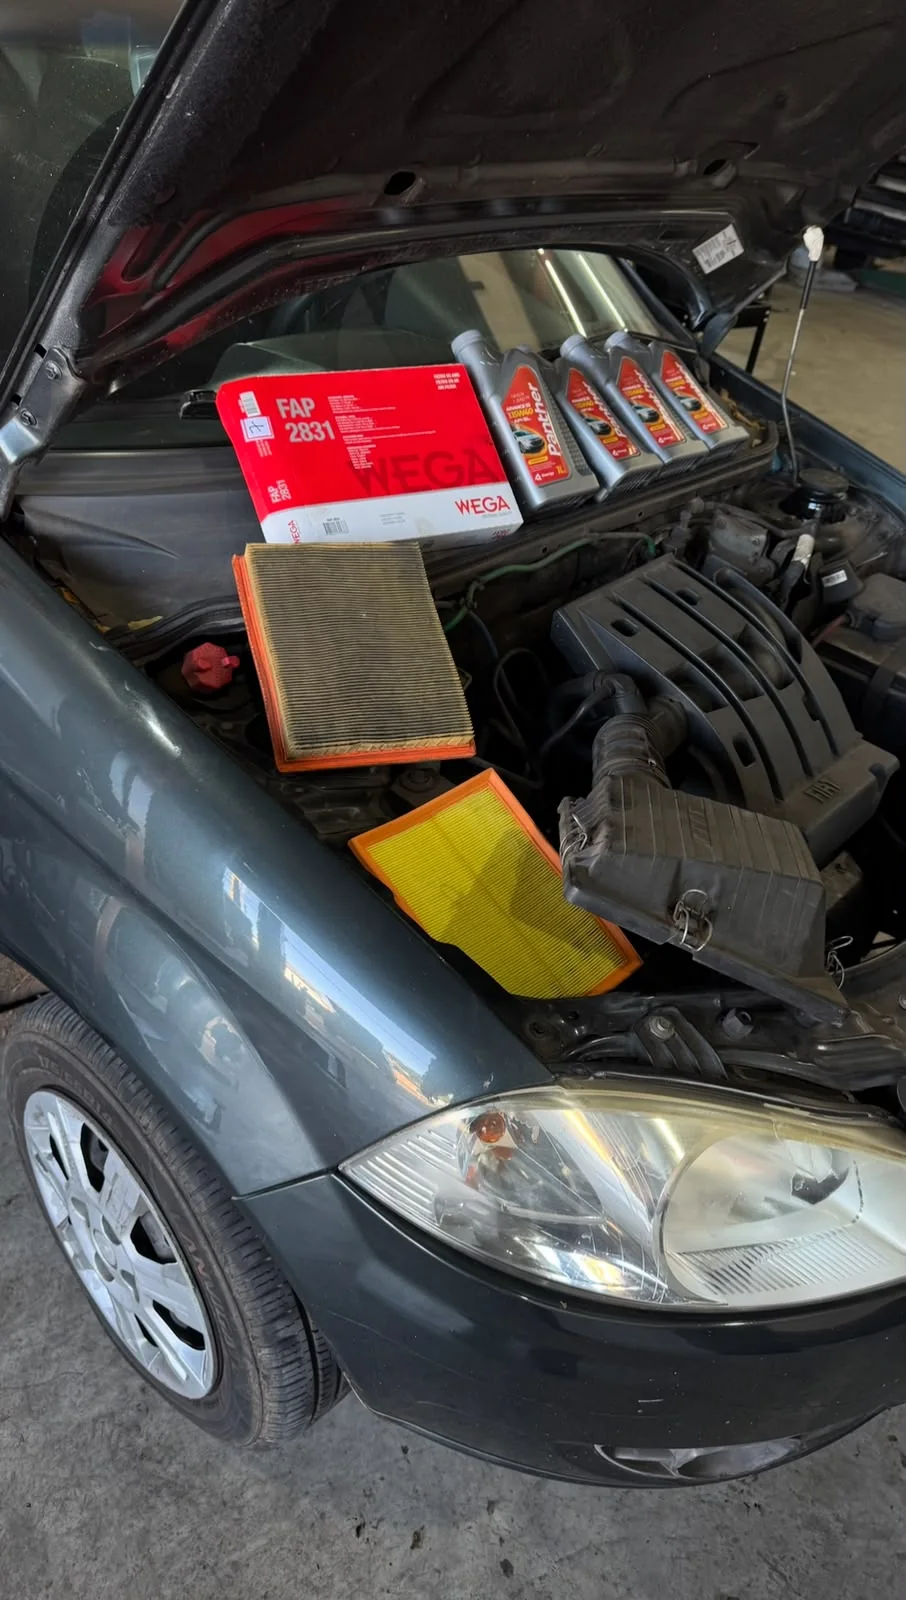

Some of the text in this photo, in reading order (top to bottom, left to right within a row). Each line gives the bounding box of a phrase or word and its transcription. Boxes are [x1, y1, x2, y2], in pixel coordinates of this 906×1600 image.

[276, 397, 315, 418] FAP
[527, 382, 562, 457] Panther
[285, 420, 335, 443] 2831
[347, 450, 500, 496] WEGA
[267, 486, 281, 504] FAP
[276, 480, 292, 501] 2831
[455, 496, 511, 516] WEGA
